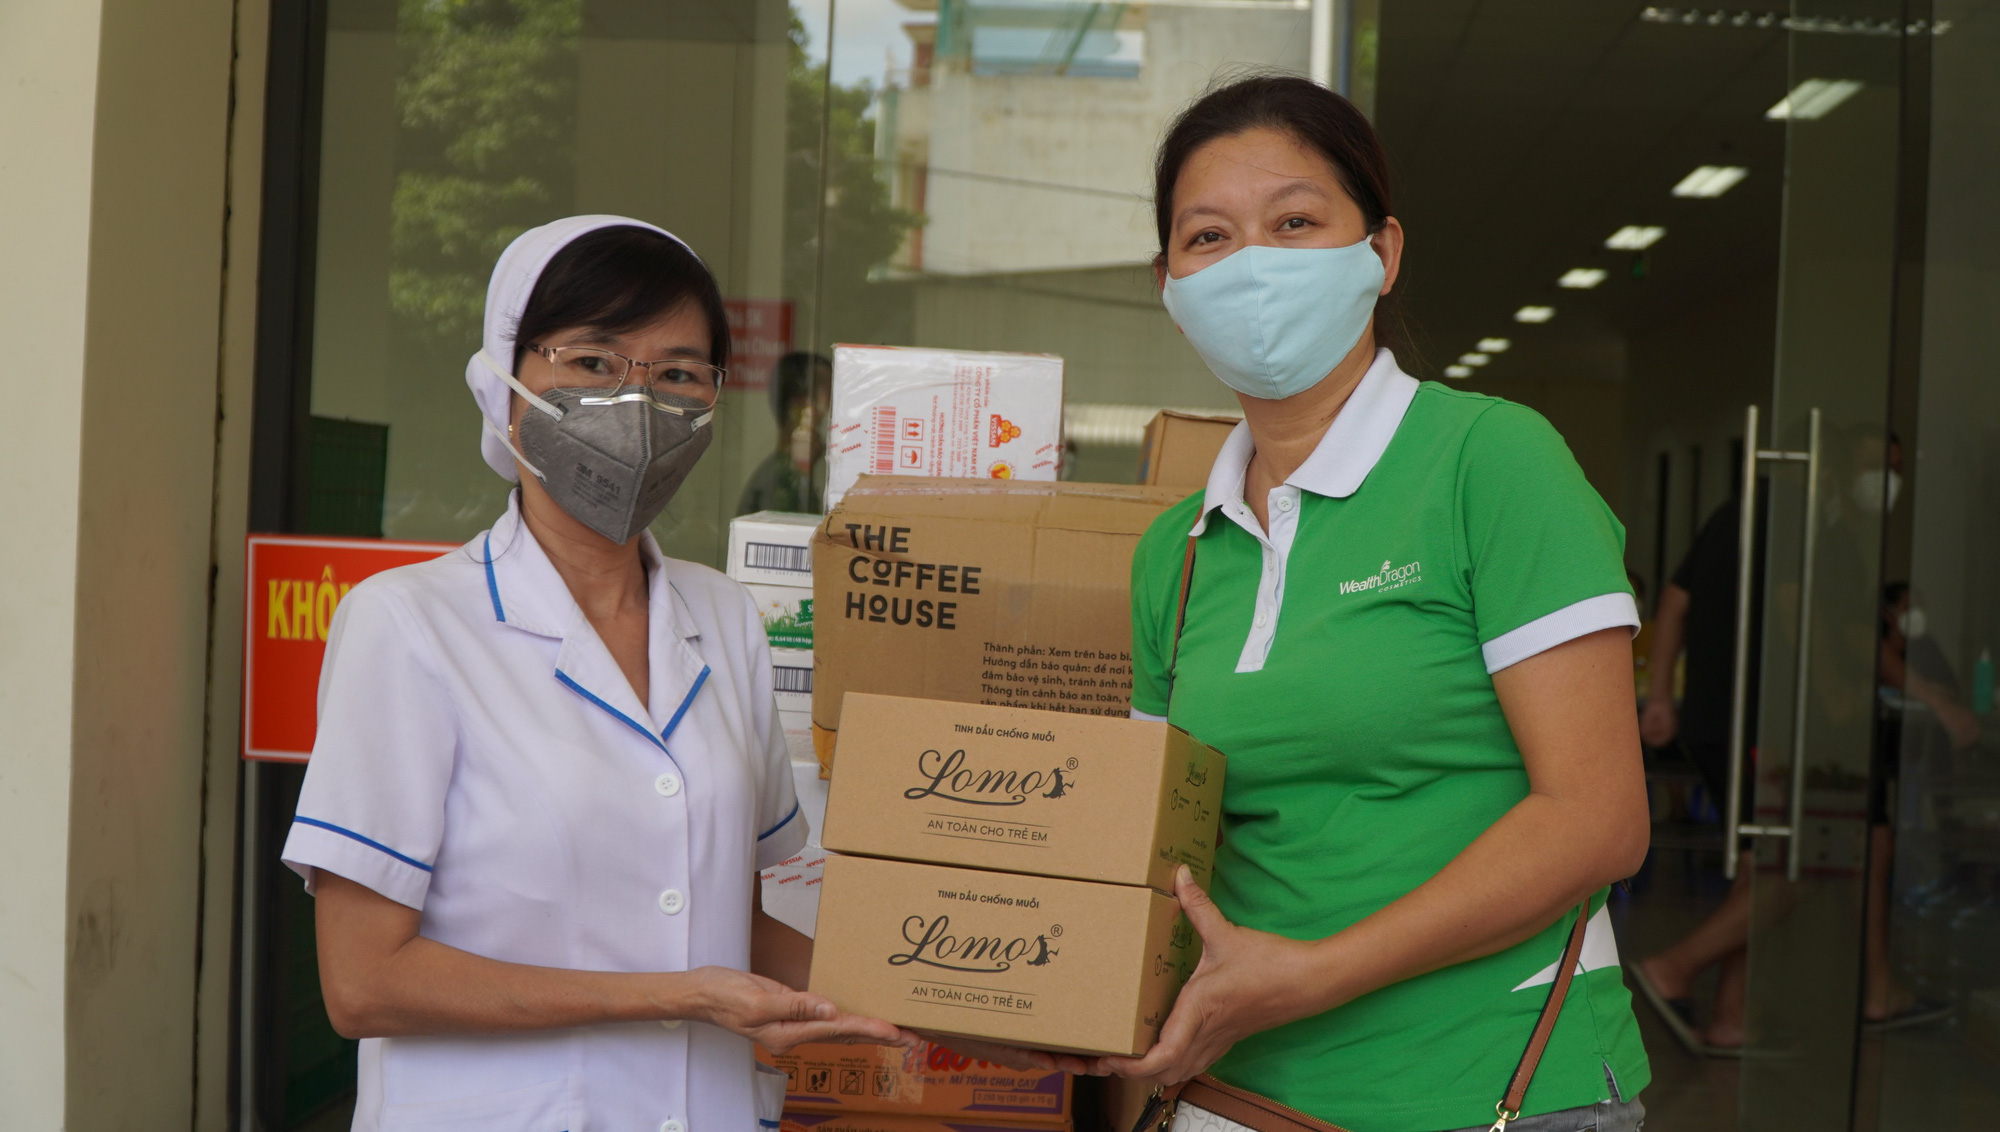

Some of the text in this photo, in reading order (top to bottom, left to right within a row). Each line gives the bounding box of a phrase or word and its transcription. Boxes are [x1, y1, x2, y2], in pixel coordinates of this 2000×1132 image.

[974, 388, 981, 397] TY
[990, 416, 998, 446] VISSAN
[840, 443, 862, 454] VISSAN
[576, 462, 621, 494] 3M 9541
[845, 523, 911, 553] THE
[848, 555, 982, 595] COFFEE
[1378, 575, 1422, 593] COSMETICS
[267, 563, 348, 642] KHÔ
[845, 591, 957, 630] HOUSE
[984, 642, 1014, 654] Thành
[1016, 645, 1045, 657] phần:
[1048, 647, 1071, 658] Xem
[1074, 649, 1095, 659] trên
[1098, 650, 1117, 661] bao
[983, 656, 1017, 670] Hướng
[1019, 658, 1038, 670] dẫn
[1041, 660, 1060, 671] bảo
[1062, 663, 1091, 674] quản:
[1094, 662, 1107, 674] để
[1109, 665, 1125, 675] nơi
[982, 671, 1133, 690] đảm bảo vệ sinh, tránh ánh nắ
[981, 684, 1013, 698] Thông
[1016, 687, 1029, 697] tin
[1032, 687, 1056, 699] cảnh
[1059, 689, 1078, 700] báo
[1080, 692, 1093, 701] an
[1095, 692, 1122, 704] toàn,
[1030, 700, 1046, 711] khi
[1104, 707, 1130, 719] dụng
[954, 724, 1055, 742] TINH DẦU CHỐNG MUỖI
[927, 819, 1048, 842] AN TOÀN CHO TRẺ EM
[806, 858, 826, 868] ISSAN
[778, 874, 802, 885] VISSAN
[805, 877, 822, 886] SSAN
[937, 890, 1039, 909] TINH DẦU CHỐNG MUỖI
[912, 986, 1032, 1010] AN TOÀN CHO TRẺ EM
[966, 1075, 987, 1086] TÔM
[989, 1078, 1015, 1088] CHUA
[1017, 1079, 1037, 1089] CAY
